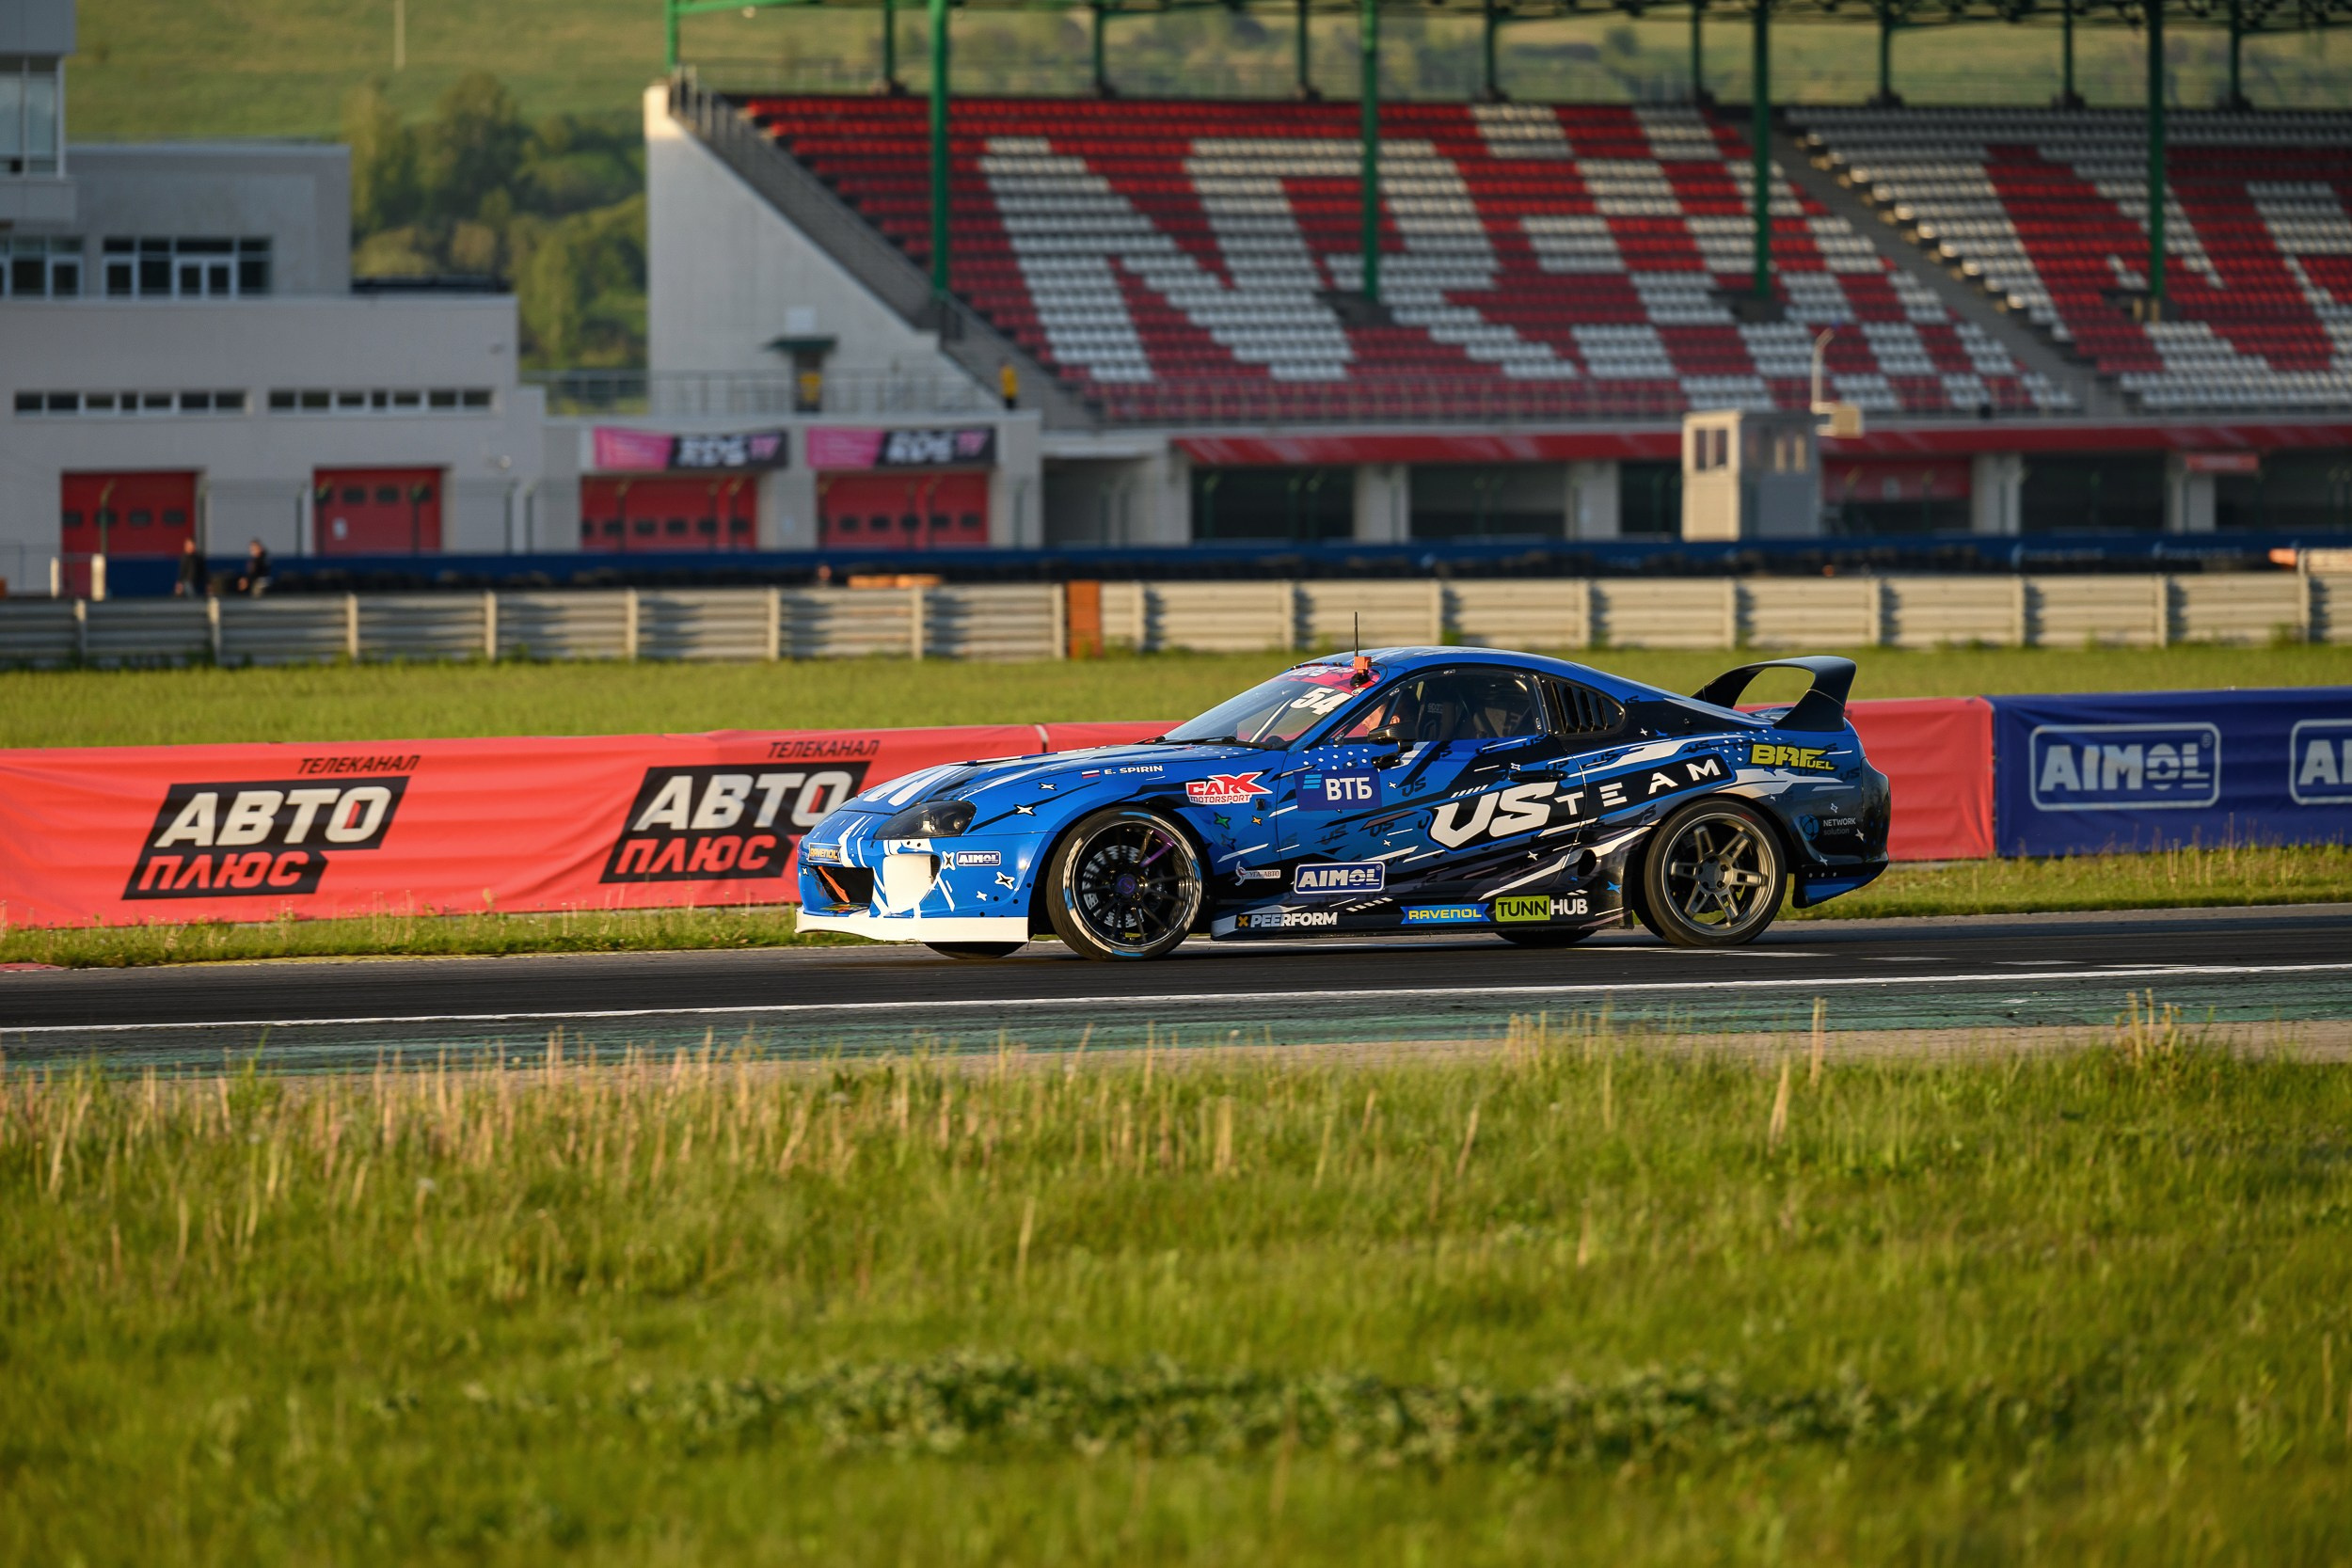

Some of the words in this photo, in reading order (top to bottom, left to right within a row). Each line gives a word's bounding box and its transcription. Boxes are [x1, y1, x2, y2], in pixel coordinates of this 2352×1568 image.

[1290, 688, 1353, 715] 54
[767, 739, 881, 759] ТЕЛЕКАНАЛ
[297, 754, 421, 775] ТЕЛЕКАНАЛ
[1120, 765, 1164, 774] SPIRIN
[2039, 743, 2210, 792] AIMOL
[1325, 777, 1373, 801] ВТБ
[1554, 758, 1722, 816] TEAM
[632, 770, 853, 832] АВТО
[1189, 794, 1250, 803] MOTORSPORT
[153, 786, 392, 848] АВТО
[1823, 817, 1856, 827] NETWORK
[614, 834, 777, 875] ПЛЮС
[958, 854, 999, 863] AIMOL
[137, 850, 310, 891] ПЛЮС
[1297, 868, 1380, 888] AIMOL
[1408, 909, 1482, 920] RAVENOL
